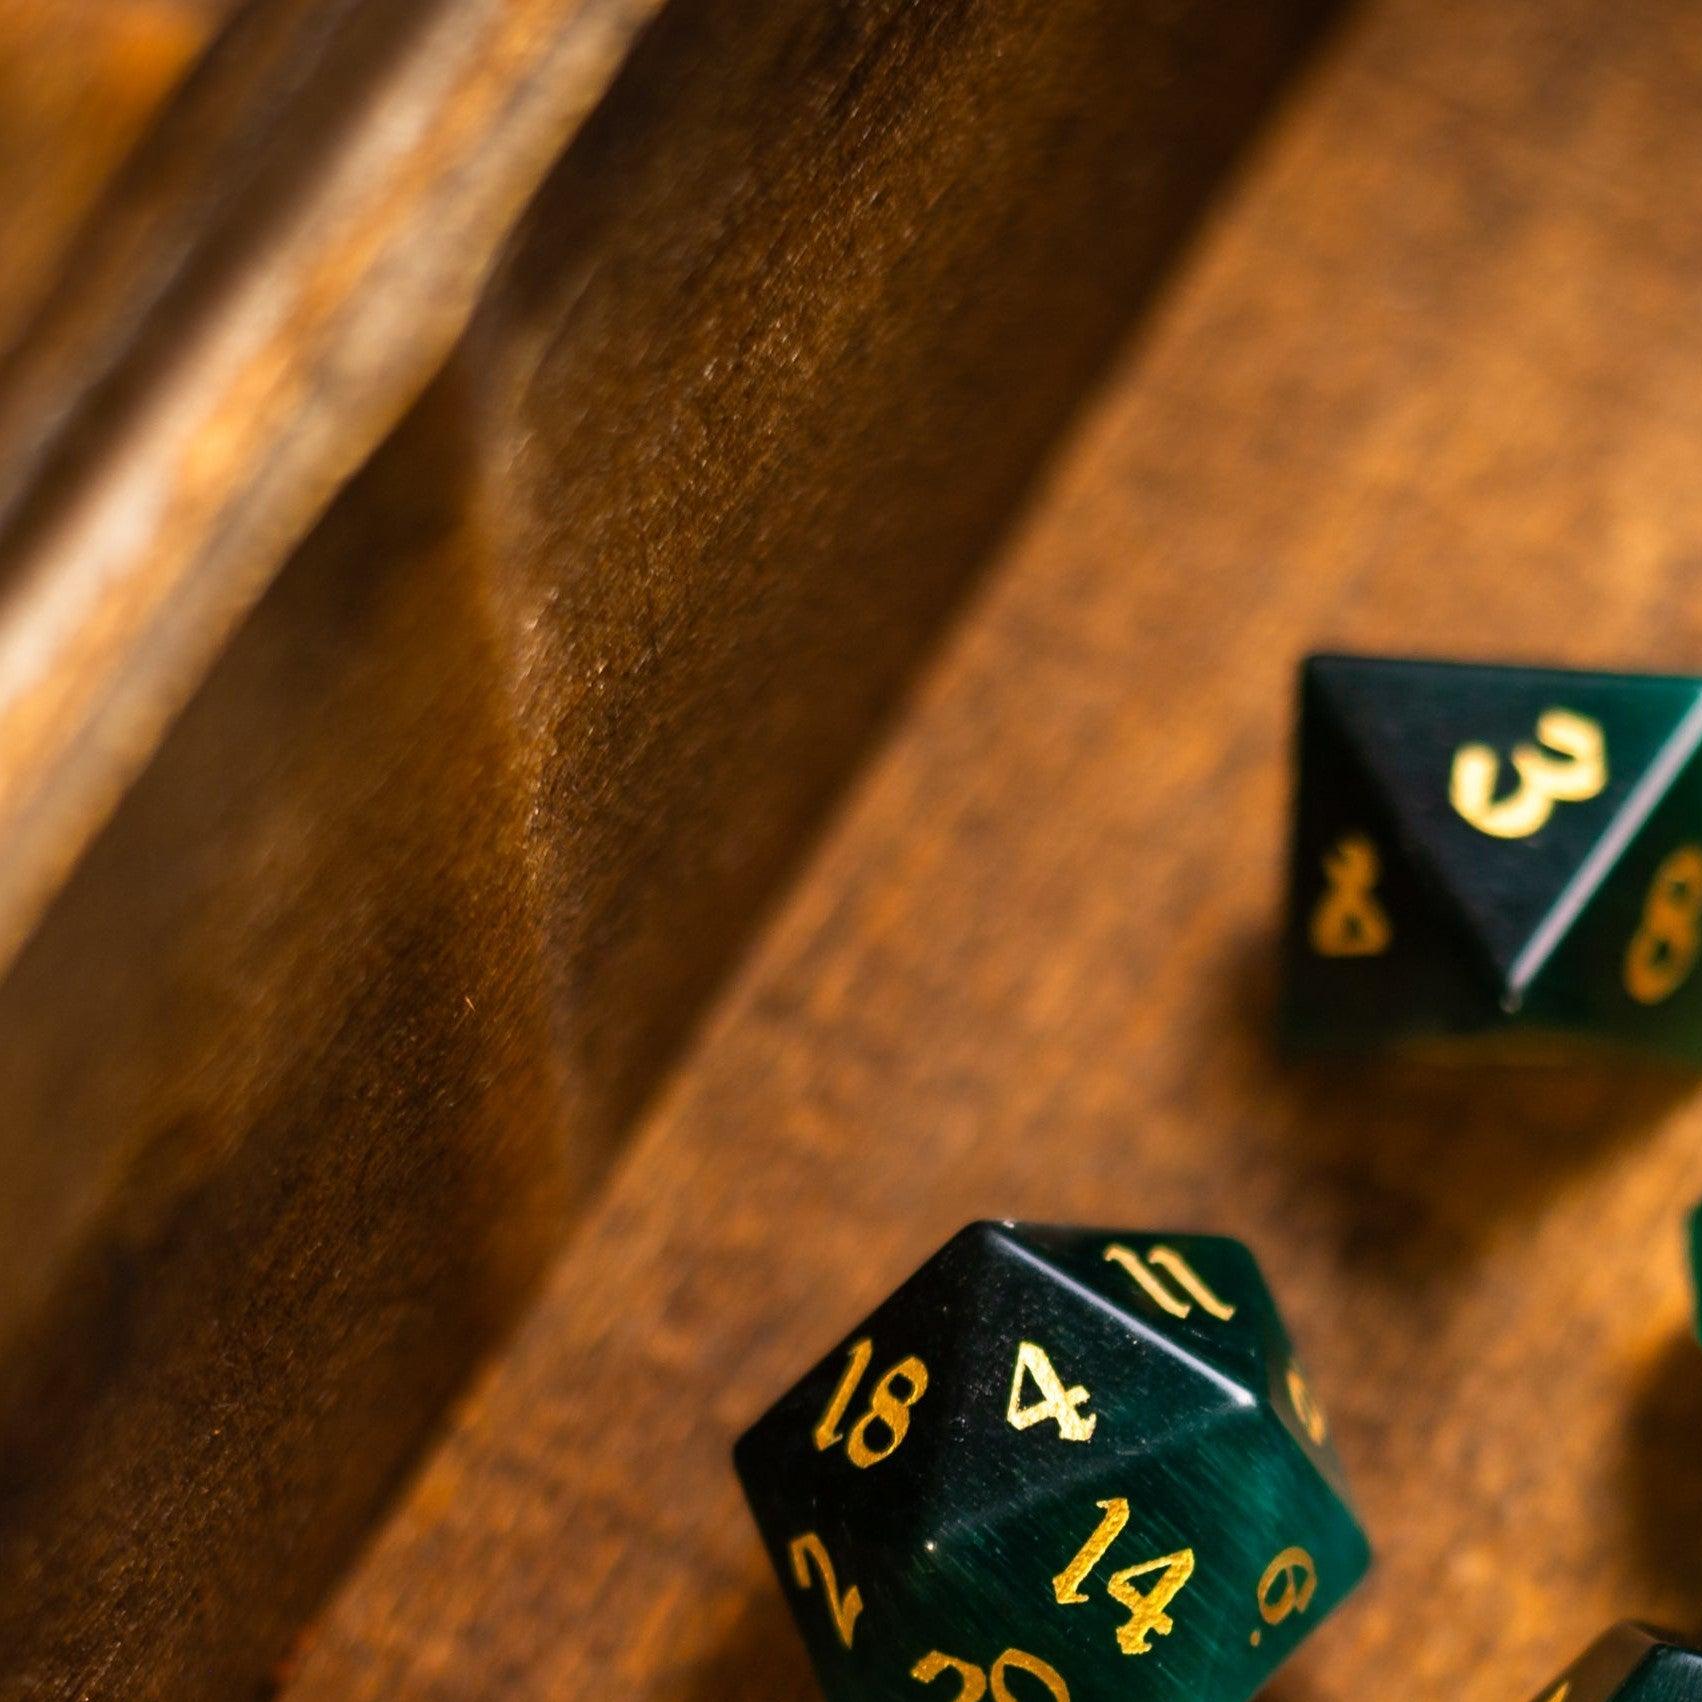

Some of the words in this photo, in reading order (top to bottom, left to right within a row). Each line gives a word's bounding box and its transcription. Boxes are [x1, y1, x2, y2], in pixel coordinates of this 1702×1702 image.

[1450, 709, 1608, 838] 3
[1105, 1244, 1236, 1321] 11
[813, 1337, 929, 1469] 18
[1007, 1341, 1097, 1442] 4
[790, 1532, 864, 1649] 2
[1052, 1497, 1194, 1655] 14
